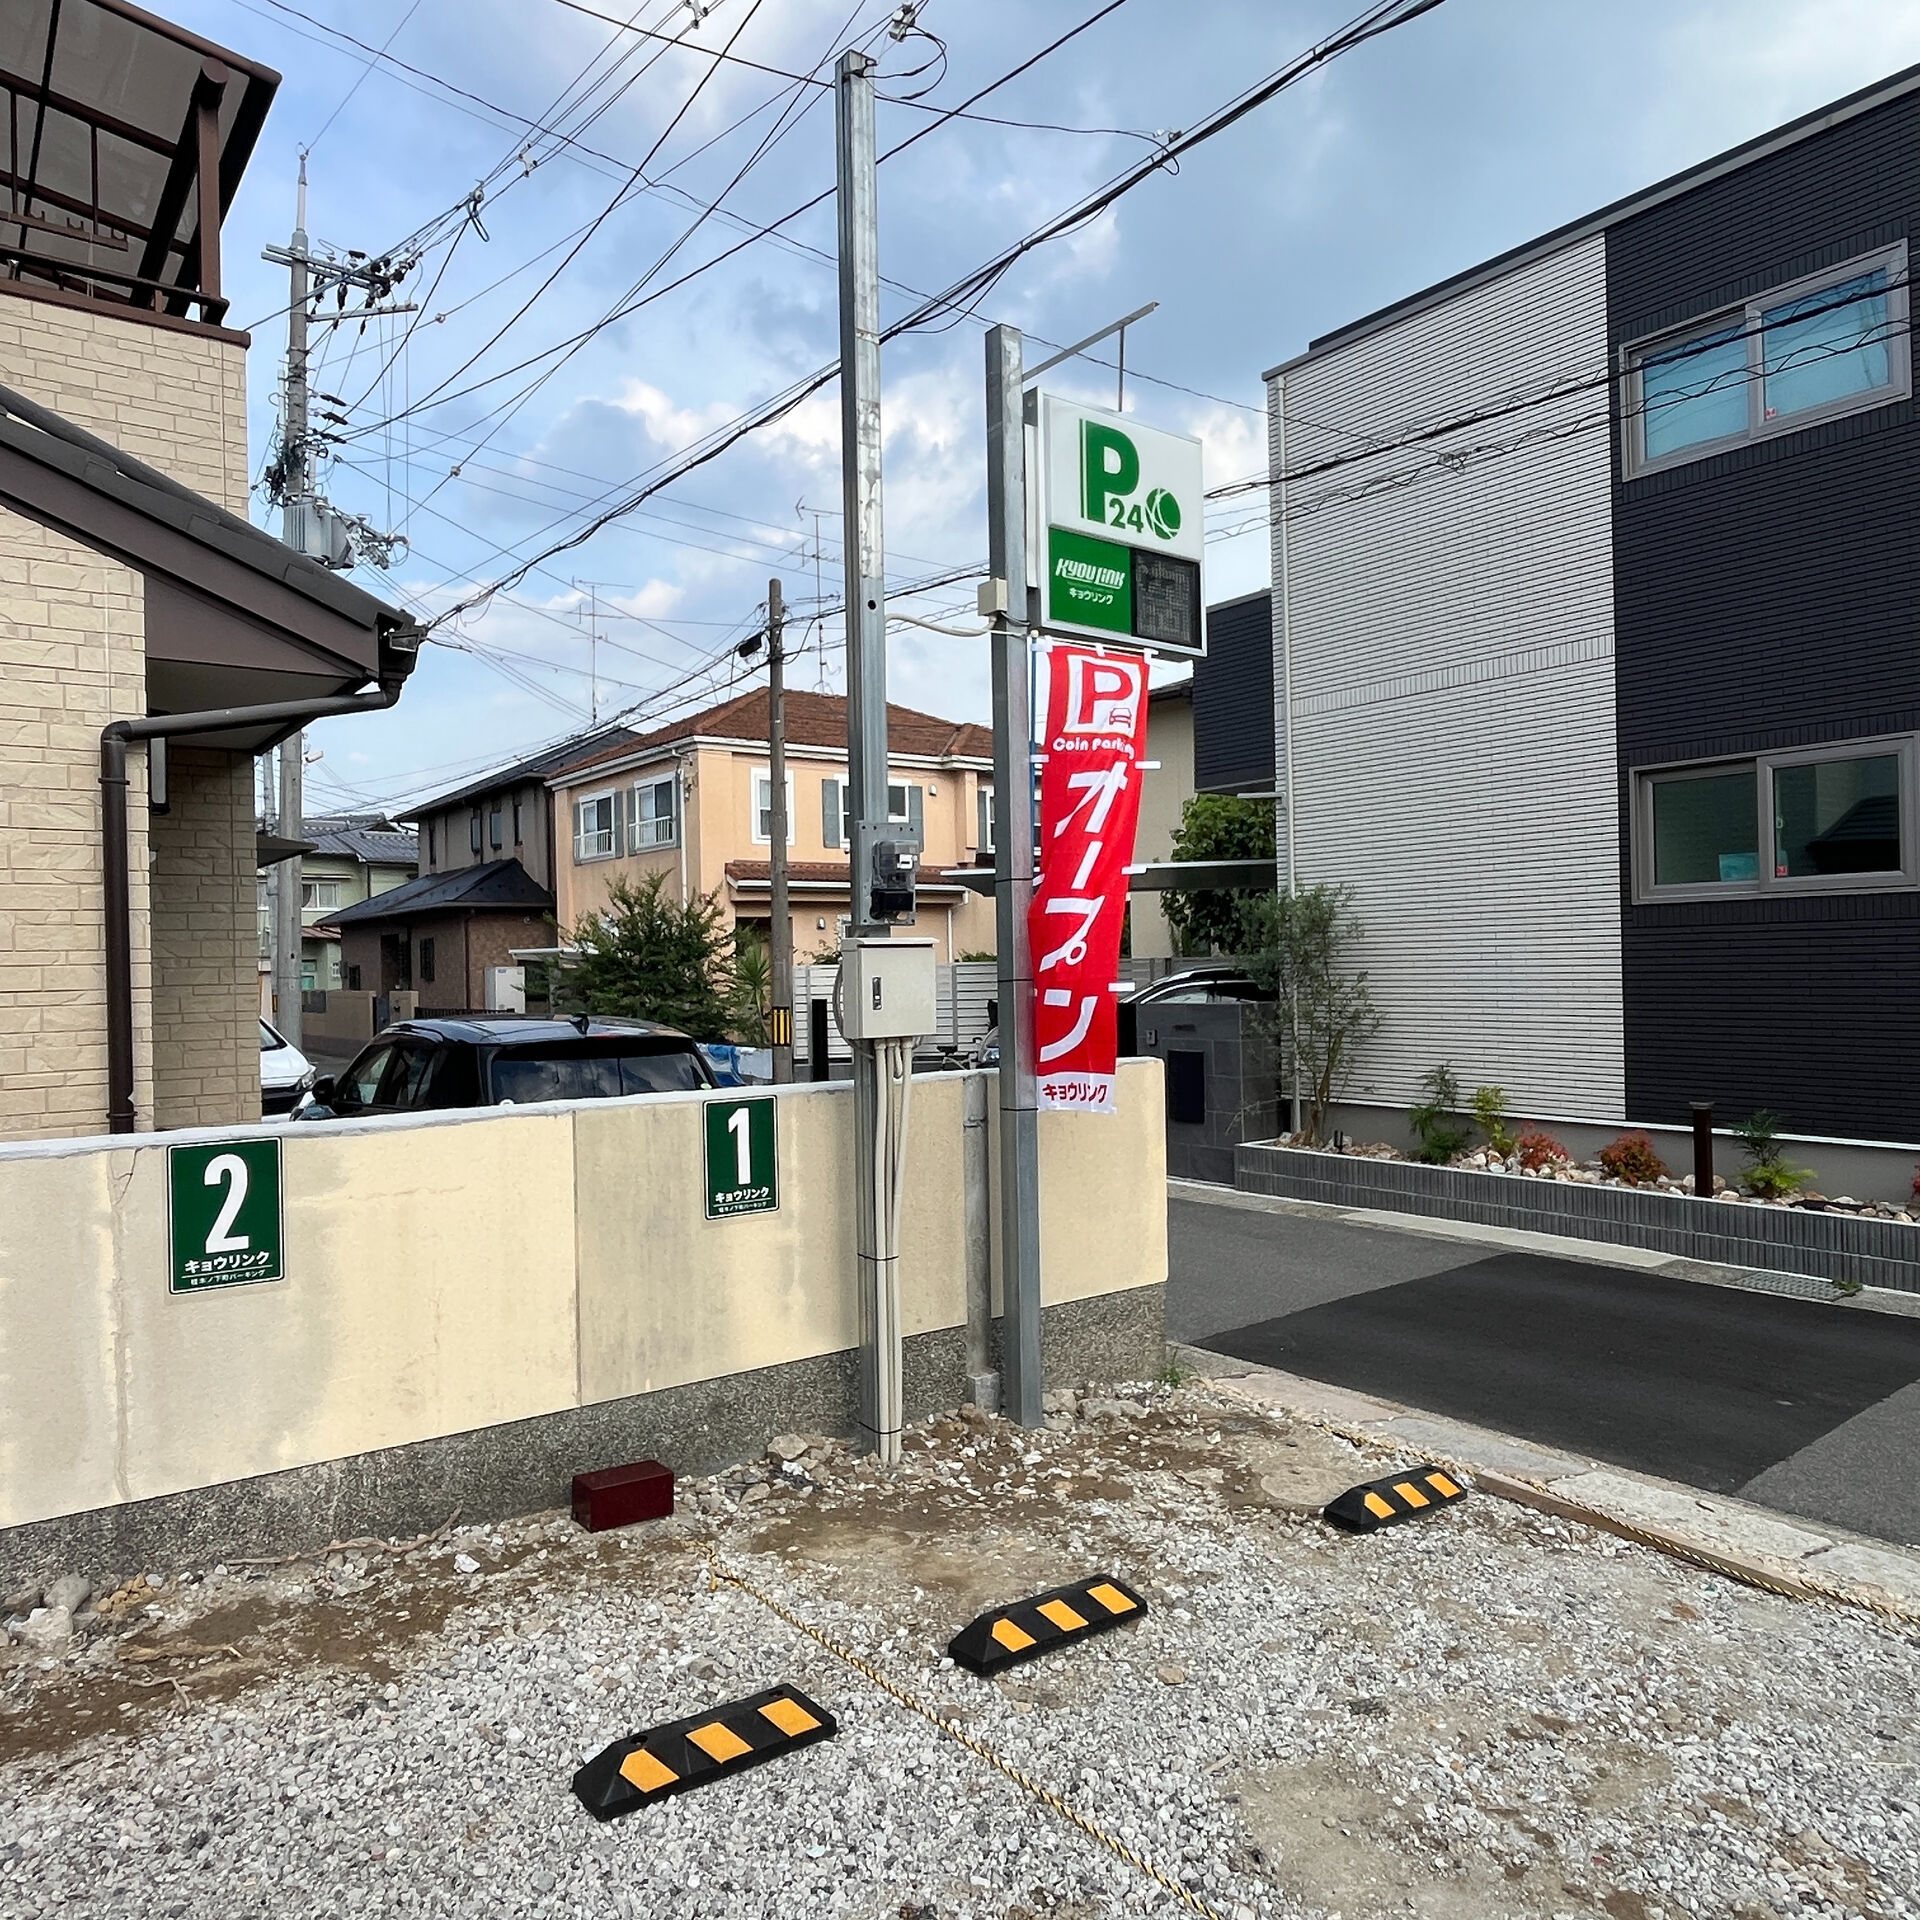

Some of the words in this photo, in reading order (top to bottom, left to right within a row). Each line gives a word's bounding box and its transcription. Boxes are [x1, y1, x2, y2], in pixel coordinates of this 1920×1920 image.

[1079, 418, 1140, 524] P
[1109, 497, 1144, 533] 24
[1069, 587, 1113, 604] キョウリンク
[1077, 659, 1134, 725] P
[1052, 737, 1089, 752] Coin
[1039, 761, 1129, 1063] オープン
[1042, 1082, 1108, 1104] キョウリンク
[728, 1107, 751, 1185] 1
[204, 1154, 249, 1253] 2
[715, 1186, 769, 1202] キョウリンク
[185, 1251, 269, 1273] キョウリンク
